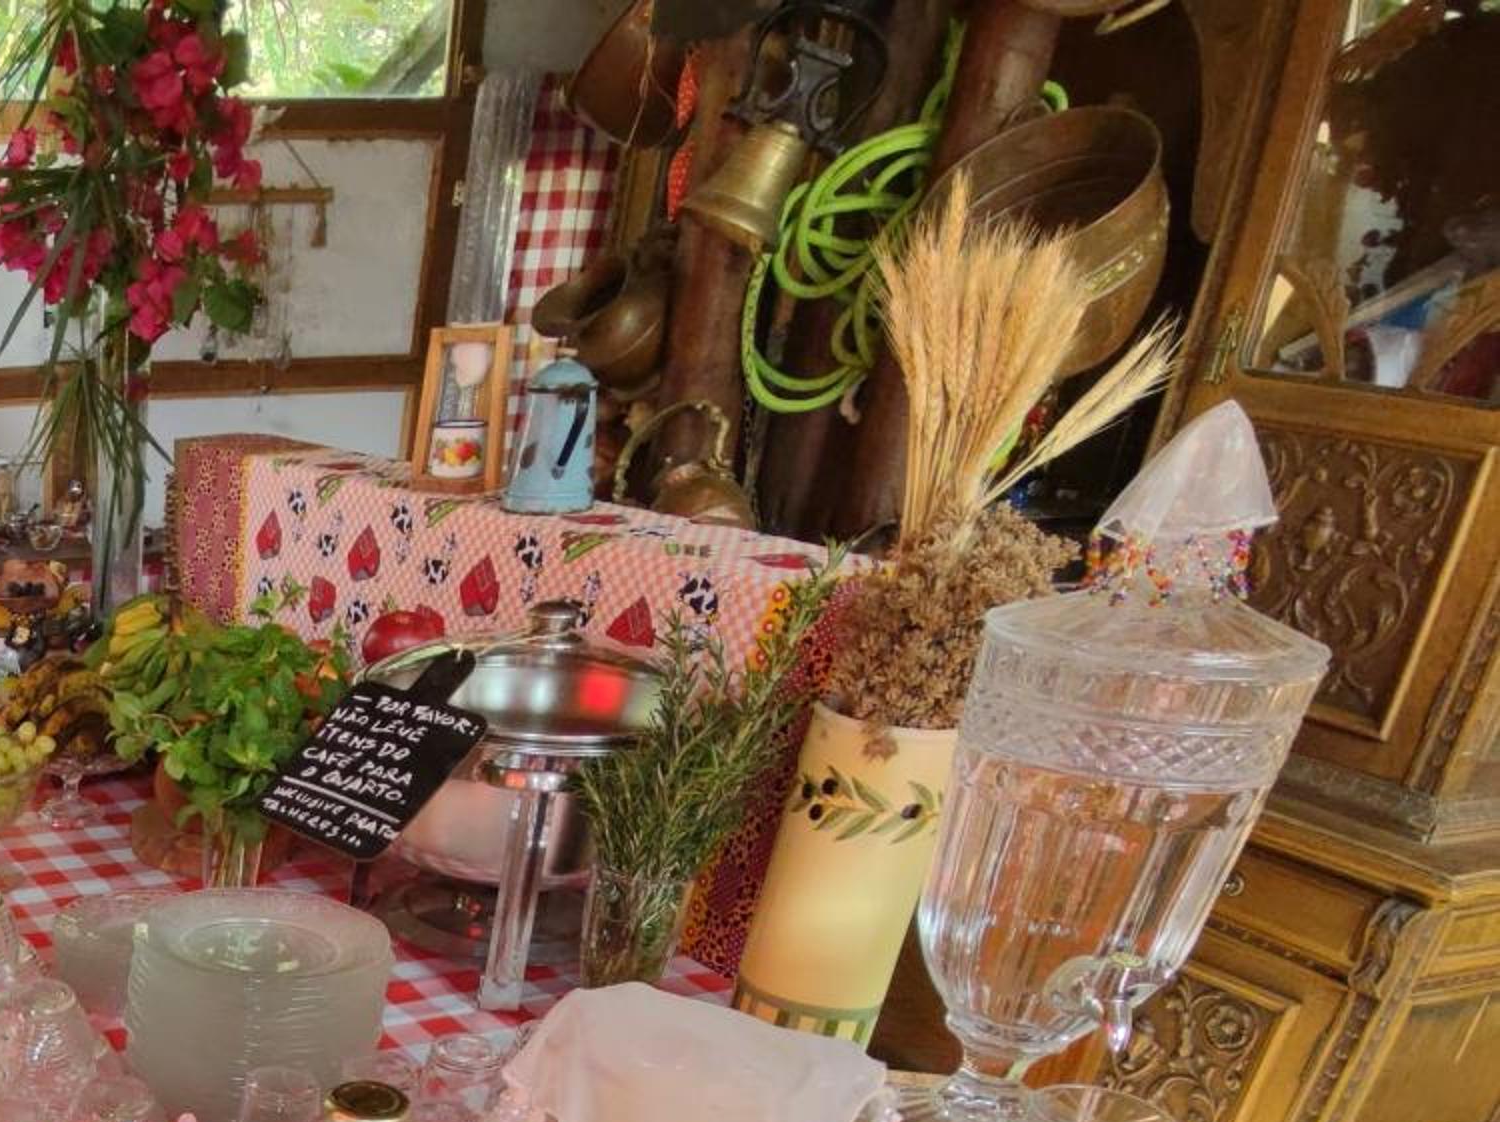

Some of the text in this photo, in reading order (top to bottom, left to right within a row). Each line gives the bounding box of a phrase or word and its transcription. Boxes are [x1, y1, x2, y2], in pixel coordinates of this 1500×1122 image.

[331, 707, 428, 742] NÃO LEVE
[375, 695, 411, 716] POR
[412, 705, 479, 736] FAVOR!
[303, 747, 413, 785] CAFÉ PARA
[378, 742, 411, 760] DO
[301, 766, 317, 777] O
